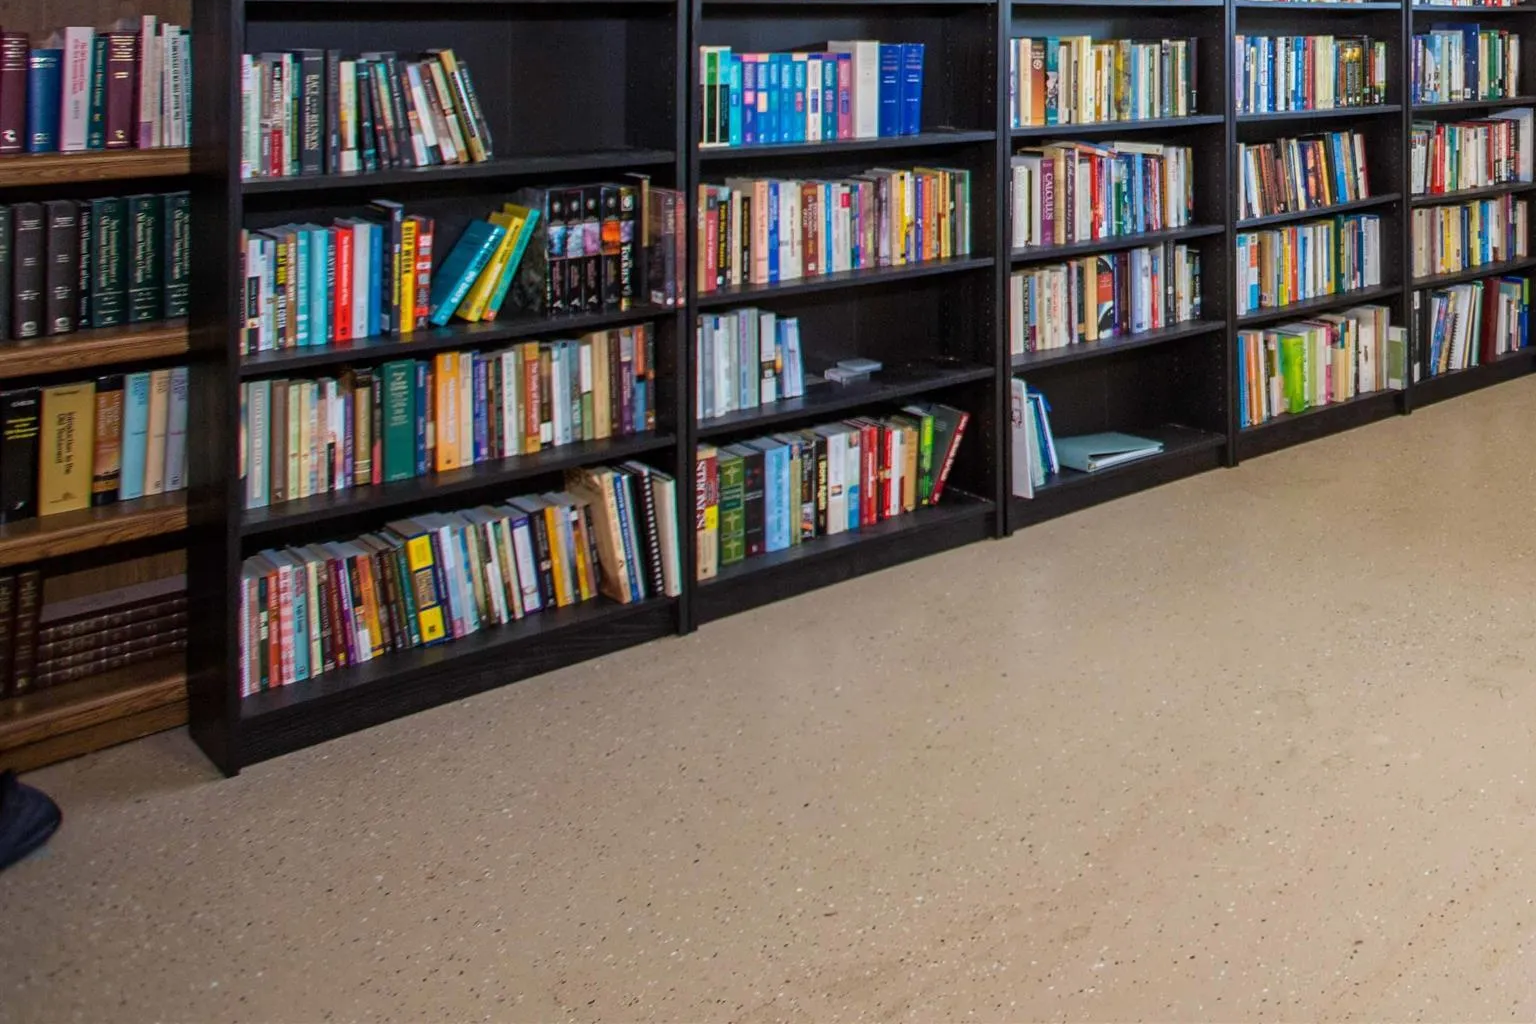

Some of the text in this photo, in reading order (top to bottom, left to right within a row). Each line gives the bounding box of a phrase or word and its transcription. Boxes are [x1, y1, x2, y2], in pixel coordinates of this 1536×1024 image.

[310, 74, 319, 94] RACE
[1046, 172, 1054, 220] CALCULUS
[404, 227, 413, 274] DEEP WORK
[621, 244, 632, 284] TOLKIEN
[449, 282, 469, 304] DAYS
[818, 485, 827, 510] Again
